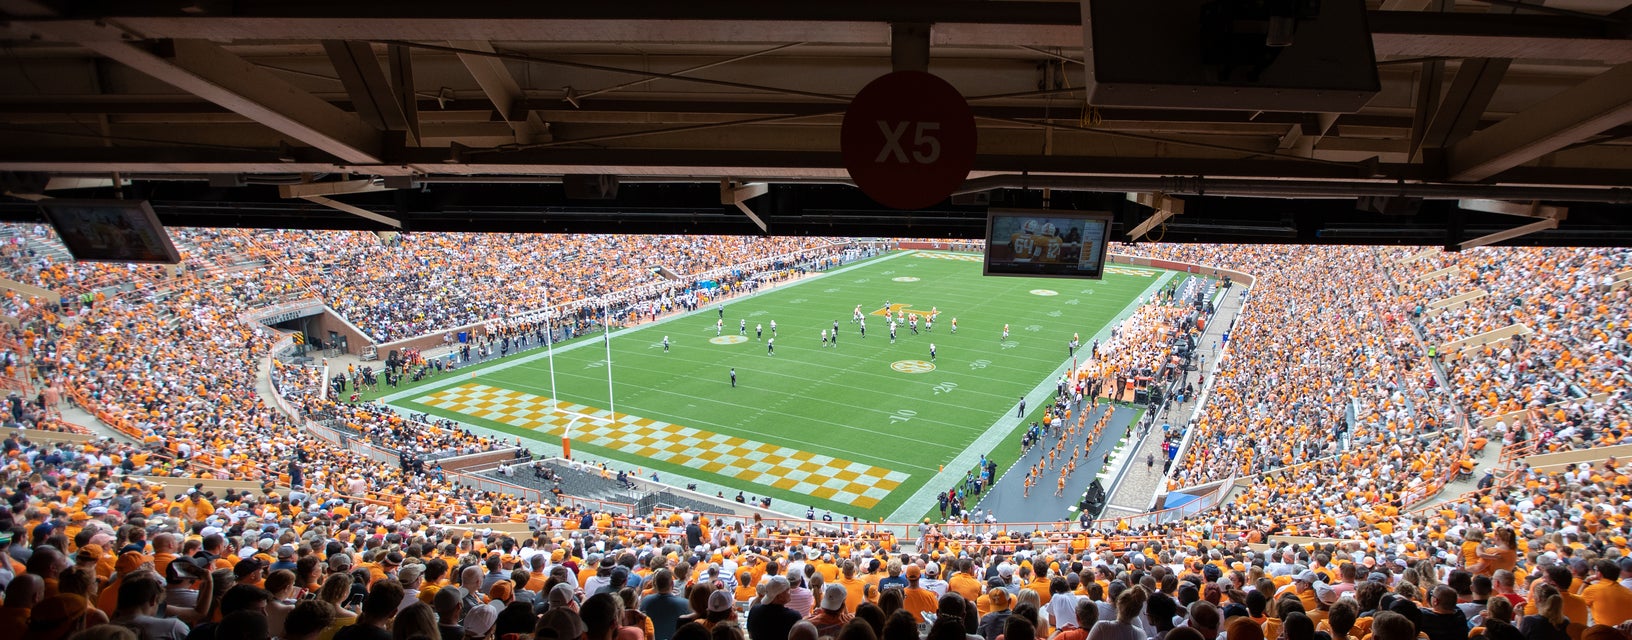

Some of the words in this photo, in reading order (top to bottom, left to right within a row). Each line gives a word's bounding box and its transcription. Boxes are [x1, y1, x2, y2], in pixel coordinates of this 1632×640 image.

[874, 120, 941, 164] X5
[1014, 238, 1035, 254] 64
[1046, 241, 1061, 258] 12
[933, 382, 958, 393] 20
[889, 410, 917, 422] 10
